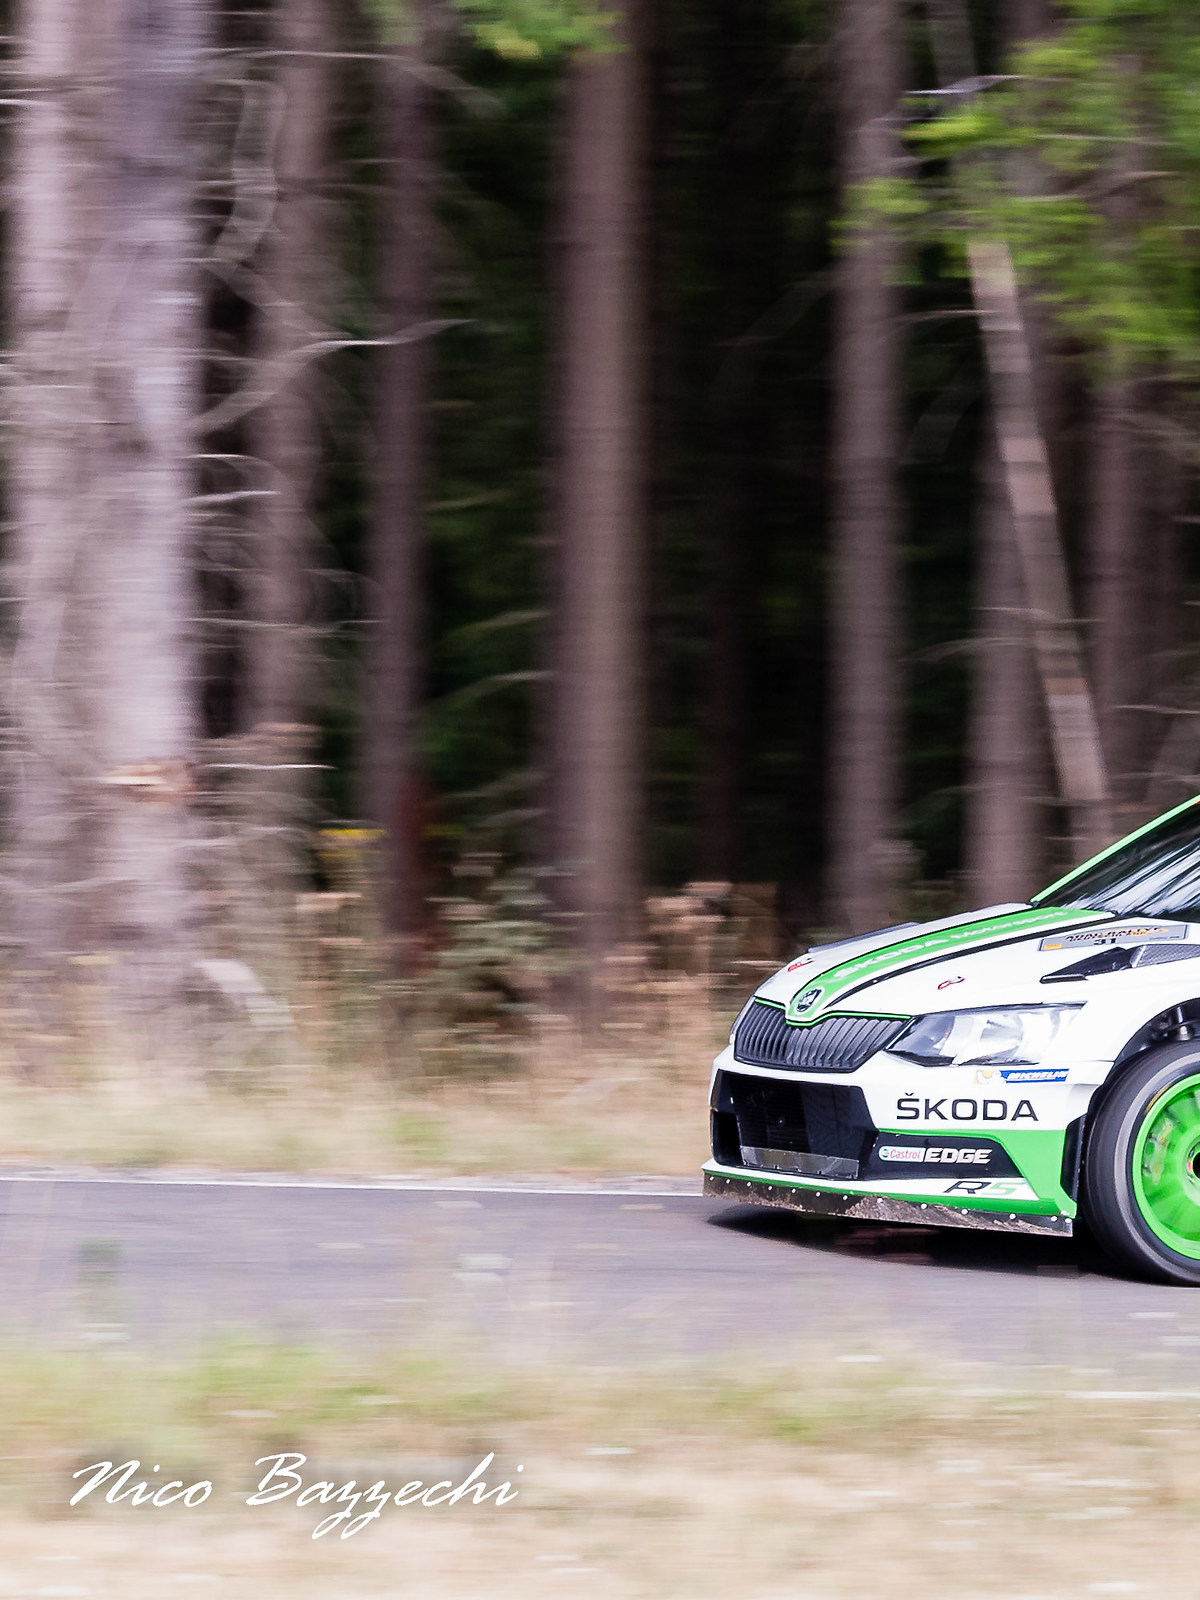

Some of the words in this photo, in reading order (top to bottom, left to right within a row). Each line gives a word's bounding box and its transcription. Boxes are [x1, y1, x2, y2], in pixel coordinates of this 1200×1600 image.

[1007, 1070, 1069, 1082] MICHELIN
[896, 1092, 1039, 1121] ŠKODA
[889, 1148, 921, 1160] Castrol
[924, 1147, 993, 1164] EDGE
[943, 1181, 1026, 1196] R5
